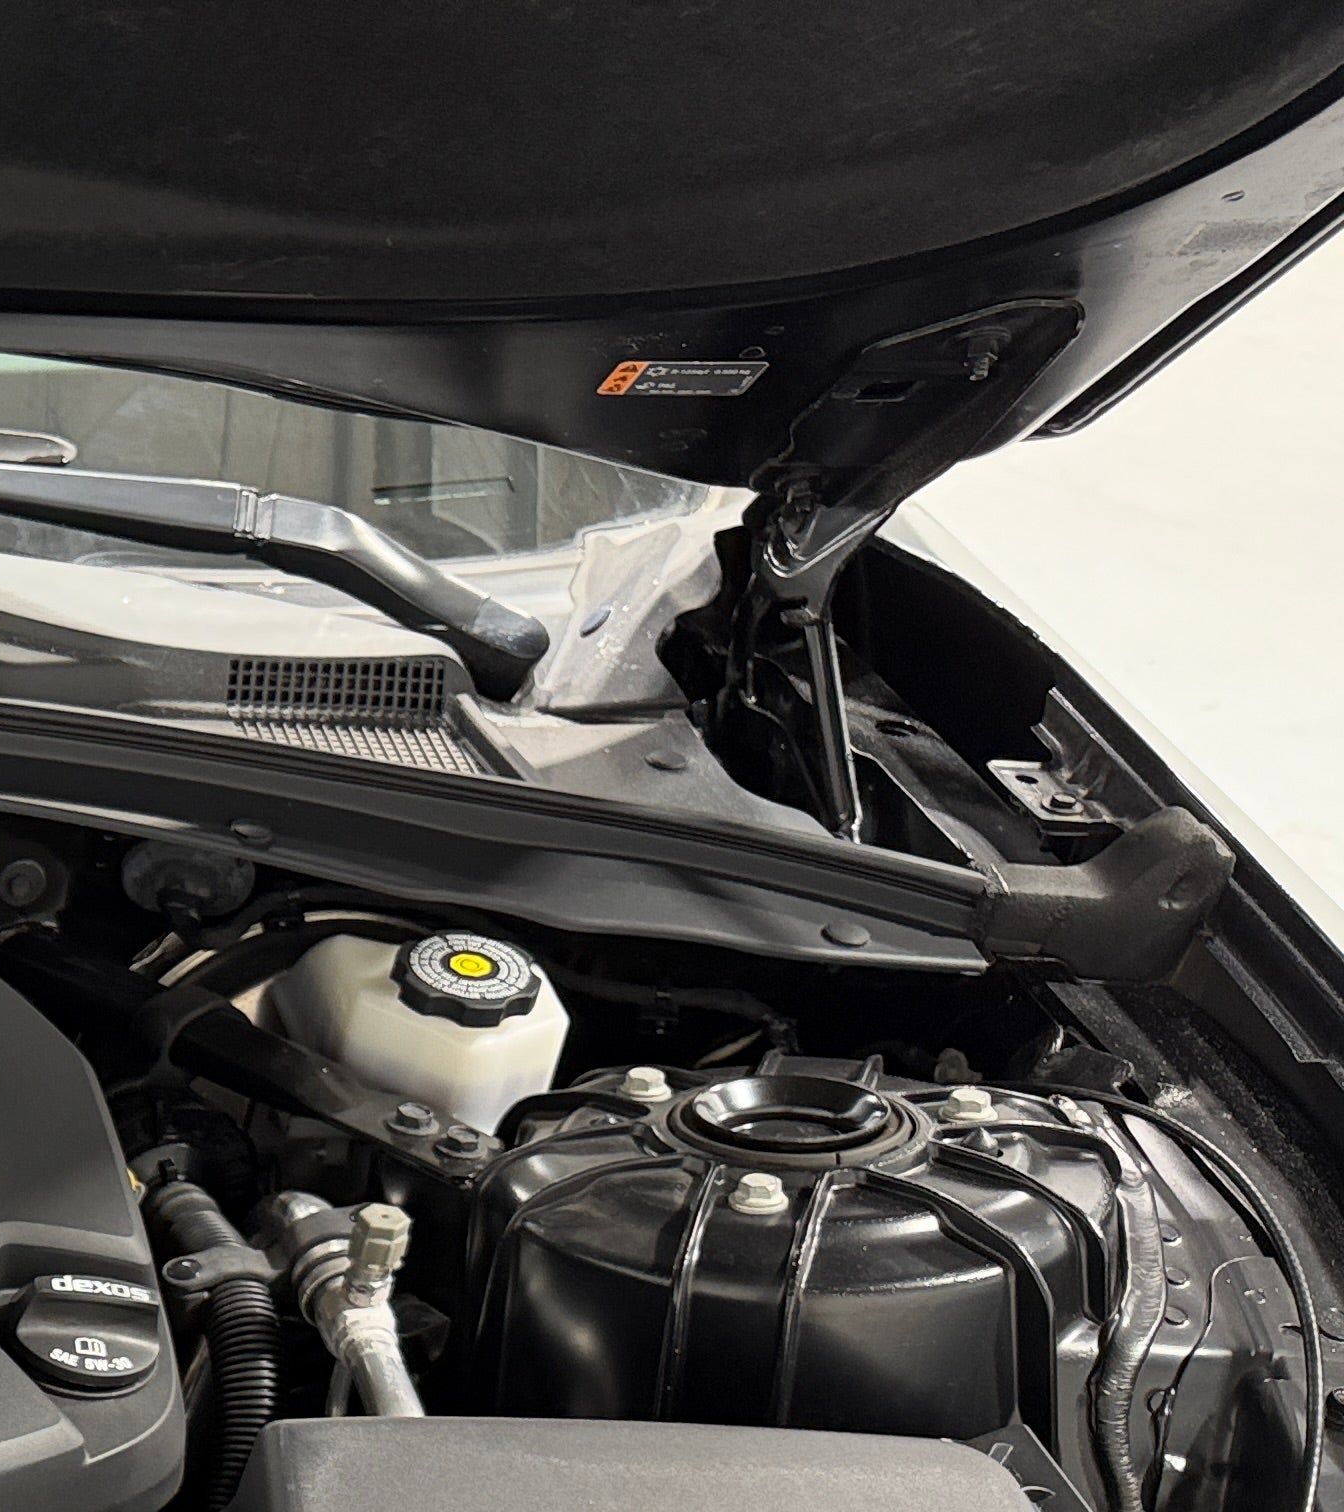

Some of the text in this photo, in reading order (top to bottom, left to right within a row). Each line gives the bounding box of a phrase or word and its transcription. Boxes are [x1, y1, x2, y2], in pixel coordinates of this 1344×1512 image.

[50, 1274, 151, 1302] dexos
[49, 1347, 134, 1373] SAE 5W-30
